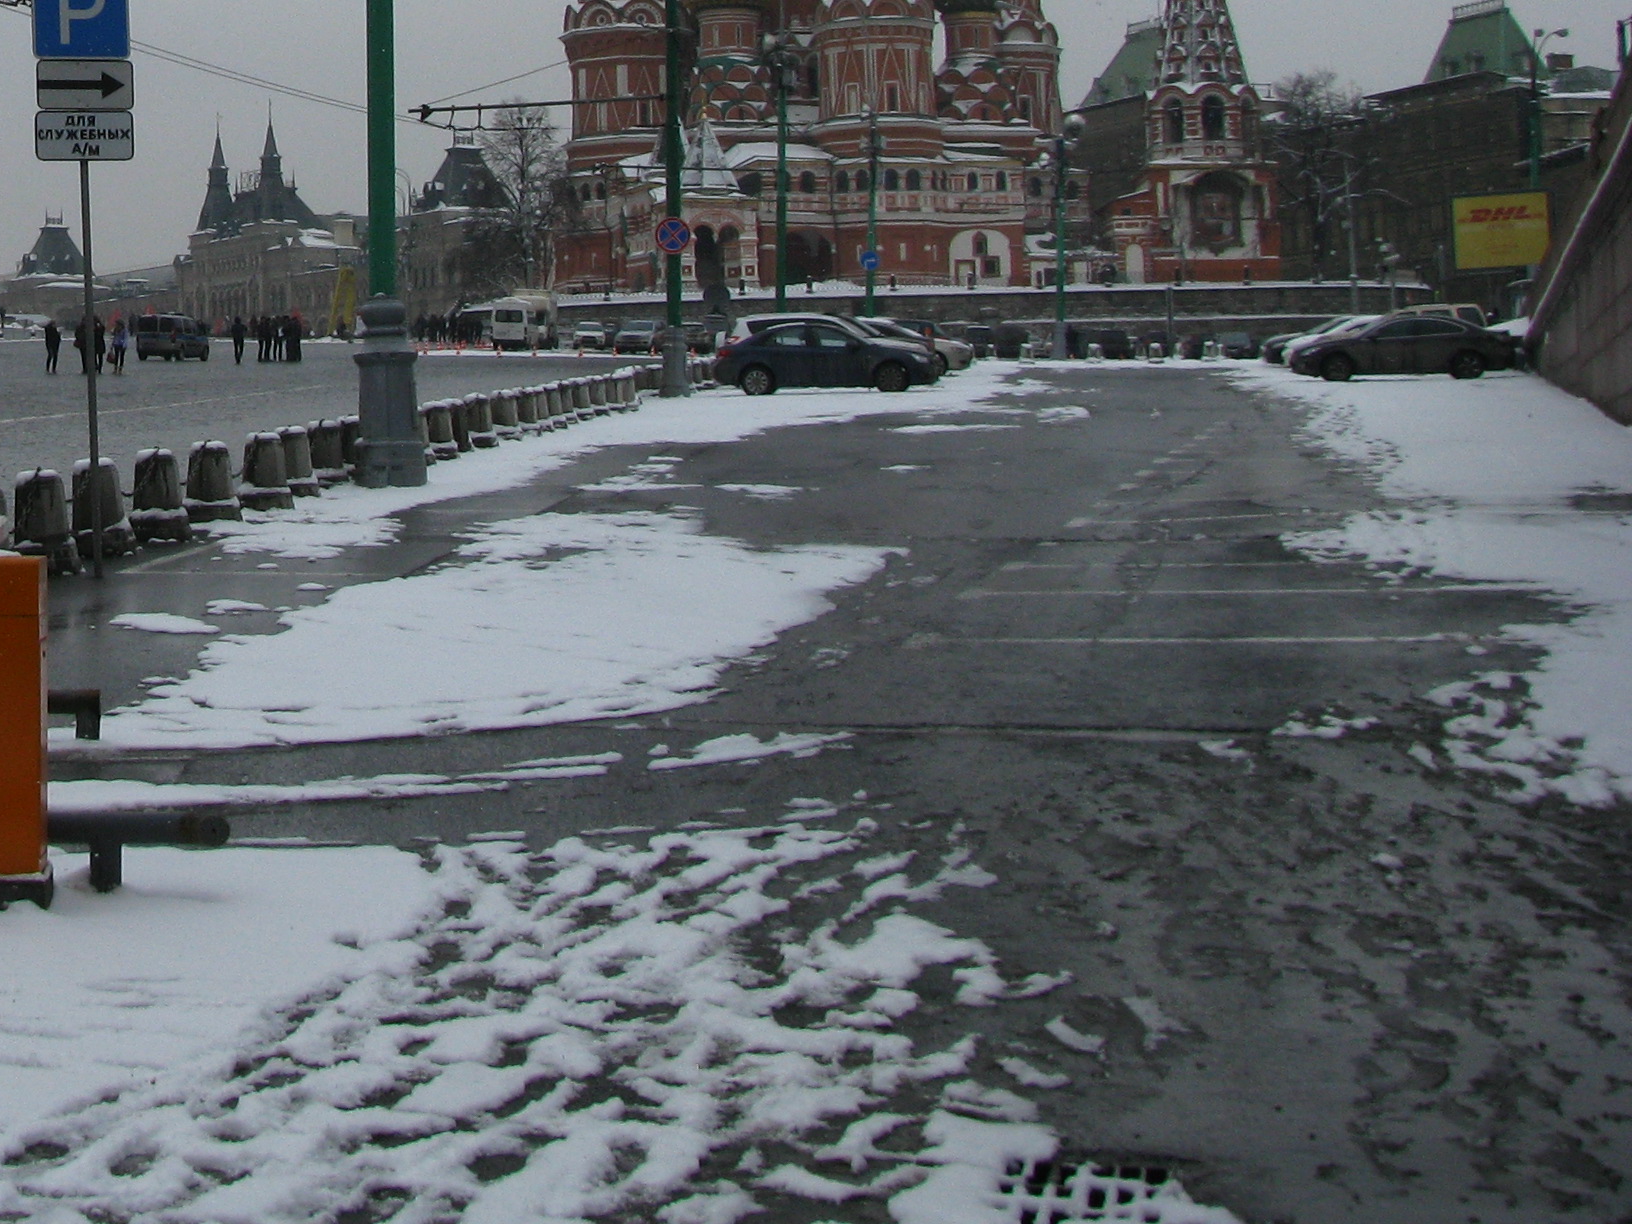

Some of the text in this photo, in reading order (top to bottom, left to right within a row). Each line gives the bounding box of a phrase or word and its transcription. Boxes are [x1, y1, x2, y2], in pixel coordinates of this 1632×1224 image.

[65, 115, 96, 127] ДЛЯ
[38, 129, 131, 140] СЛУЖЕБНЫХ
[1469, 206, 1530, 223] DHL
